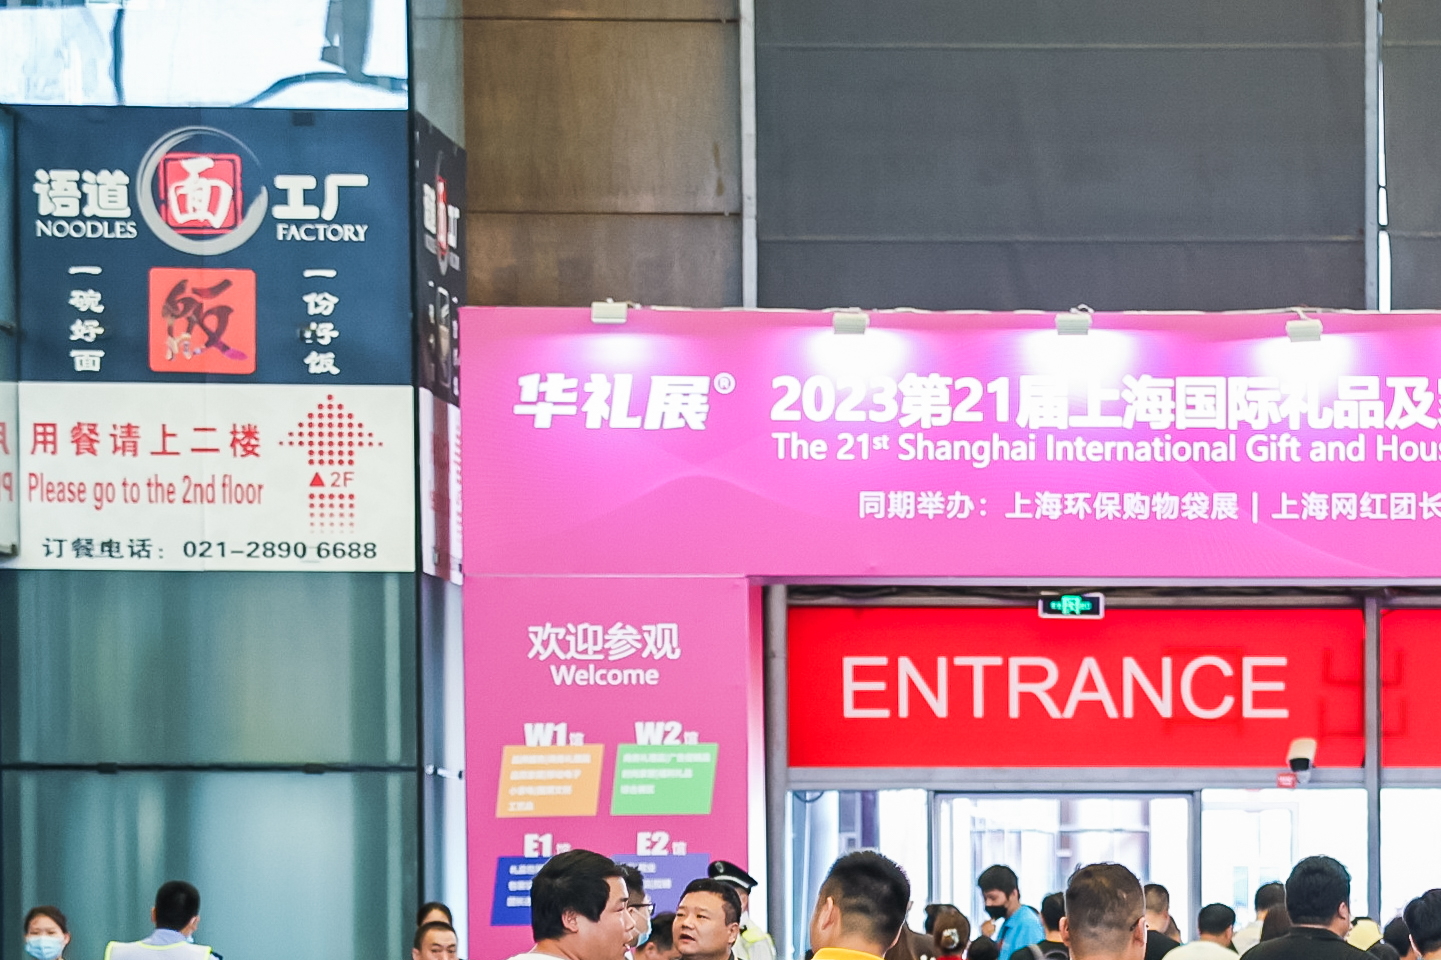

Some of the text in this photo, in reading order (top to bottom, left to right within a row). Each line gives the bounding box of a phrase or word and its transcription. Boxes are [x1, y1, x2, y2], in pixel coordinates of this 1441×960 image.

[33, 155, 369, 228] 语道 面 工厂
[35, 220, 369, 242] NOODLES FACTORY
[30, 421, 262, 458] 用餐请上二楼
[771, 432, 828, 461] The
[836, 432, 890, 461] 21st
[898, 432, 1036, 468] Shanghai
[1046, 432, 1236, 463] International
[1245, 431, 1302, 462] Gift
[1309, 431, 1366, 462] and
[28, 473, 87, 505] Please
[94, 481, 116, 511] go
[122, 477, 140, 504] to
[146, 474, 176, 504] the
[182, 474, 216, 505] 2nd
[221, 474, 264, 505] floor
[330, 472, 355, 487] 2F
[317, 541, 377, 559] 6688
[527, 622, 682, 661] 欢迎参观
[550, 664, 660, 686] Welcome
[841, 655, 1290, 721] ENTRANCE
